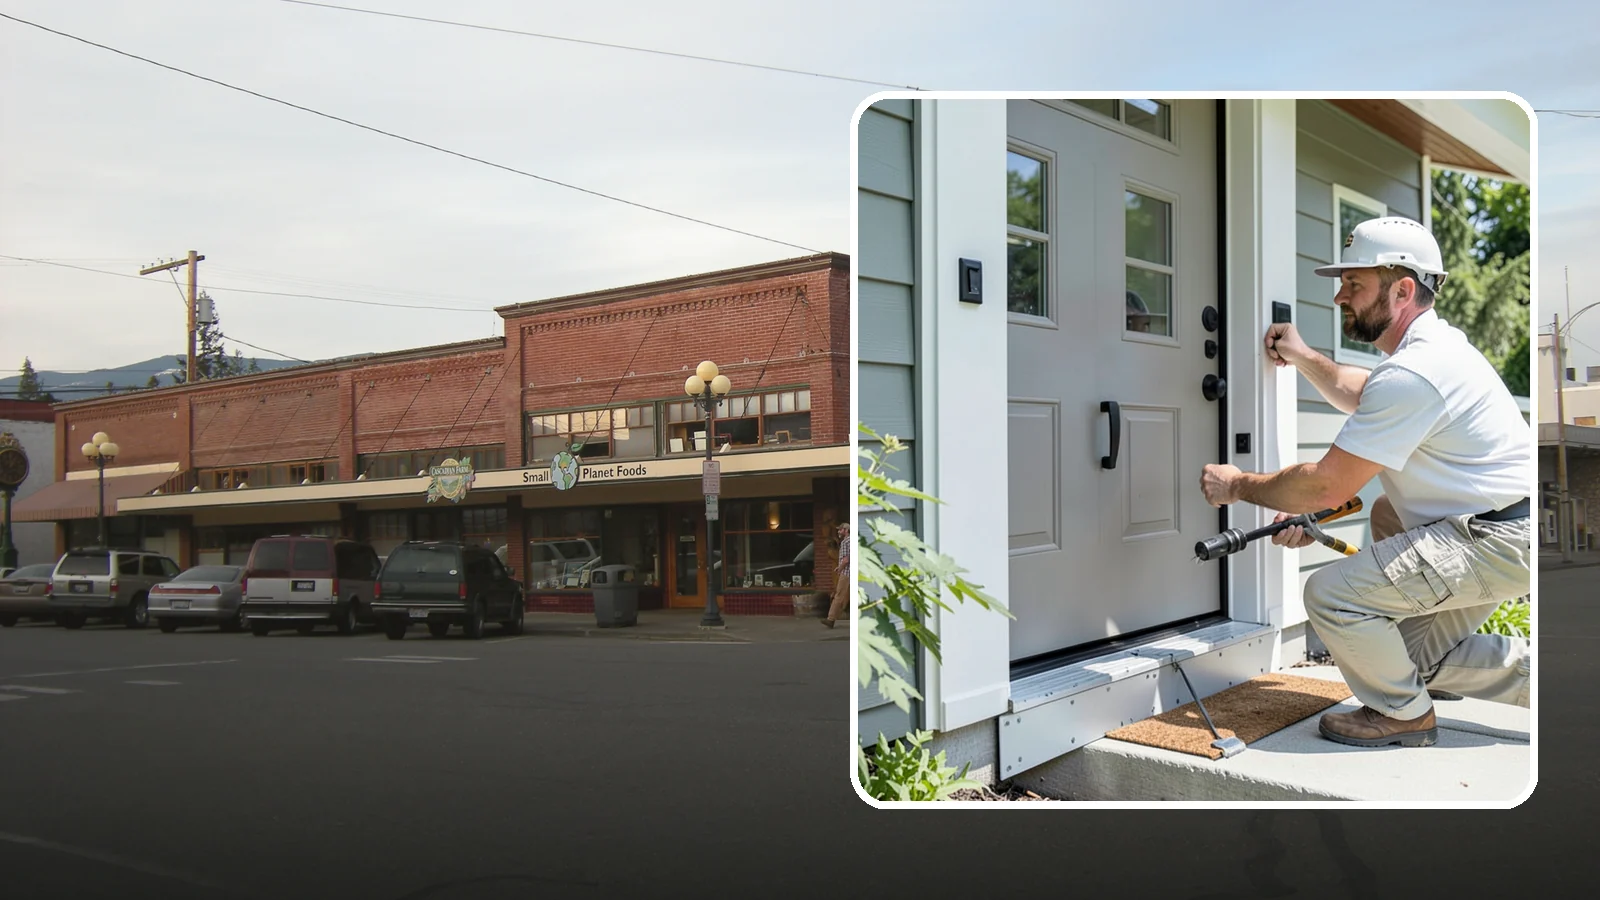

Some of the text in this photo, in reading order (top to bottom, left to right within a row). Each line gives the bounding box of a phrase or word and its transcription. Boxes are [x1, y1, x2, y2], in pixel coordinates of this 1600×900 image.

[523, 464, 647, 483] Small Planet Foods
